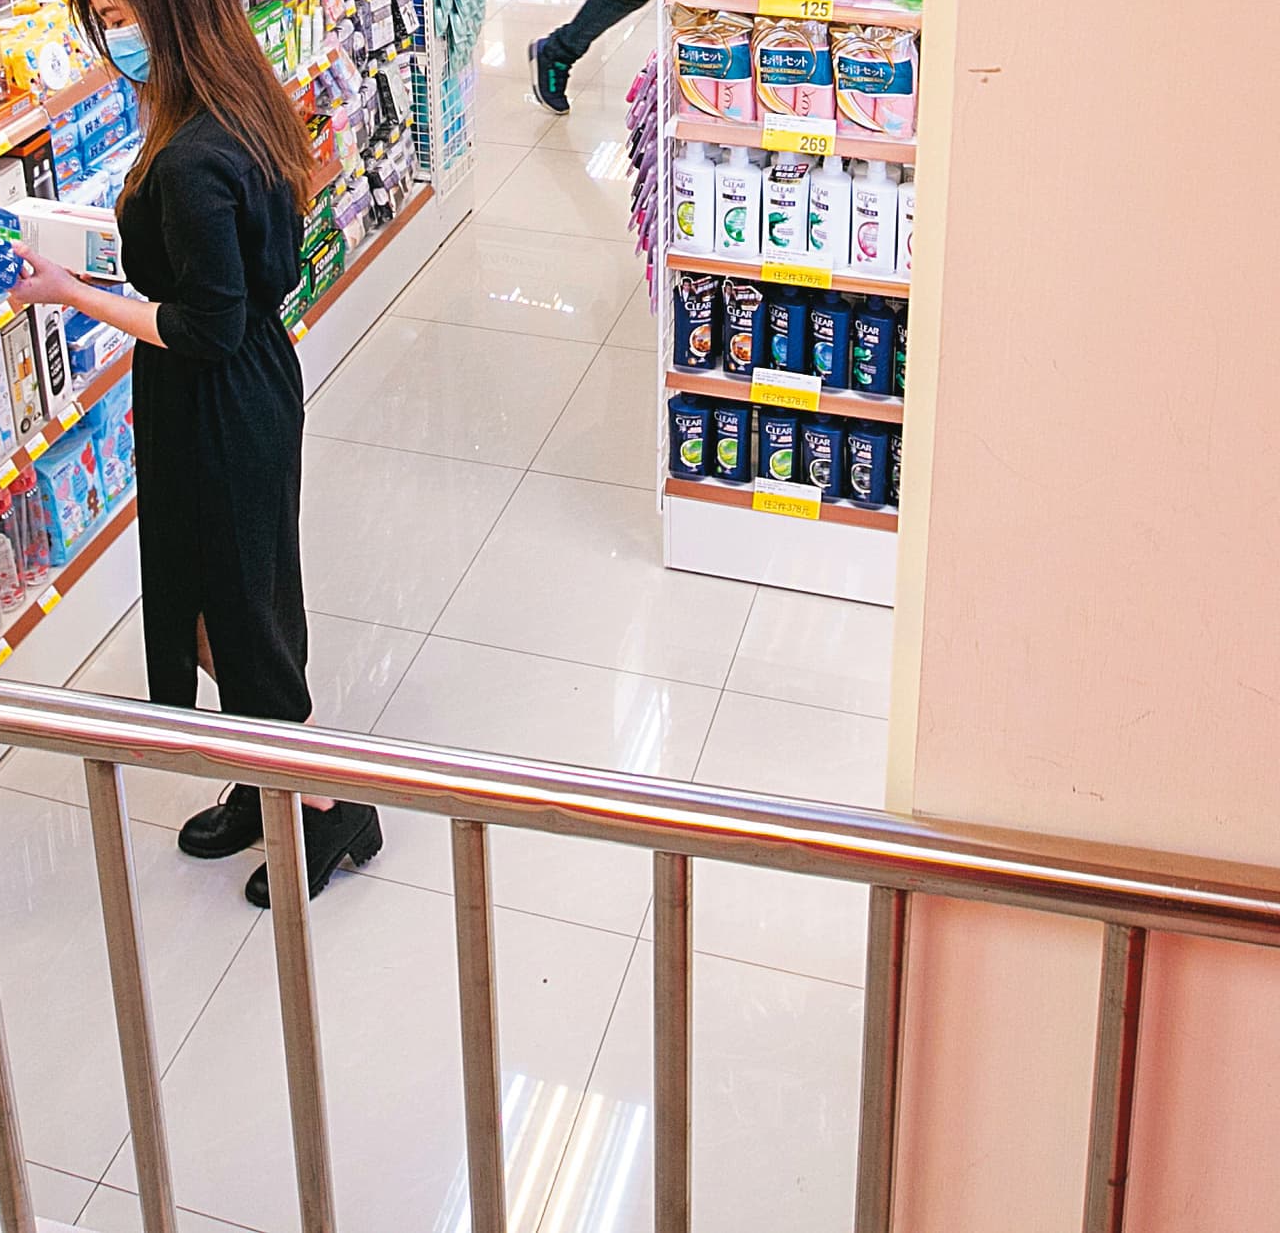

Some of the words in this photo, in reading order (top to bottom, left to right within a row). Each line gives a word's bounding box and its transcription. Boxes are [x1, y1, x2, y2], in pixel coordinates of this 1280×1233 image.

[801, 1, 829, 17] 125
[679, 49, 724, 62] お得セット
[761, 54, 809, 68] お得セット
[839, 63, 886, 77] お得セット
[799, 136, 828, 152] 269
[684, 302, 712, 311] CLEAR
[726, 305, 753, 319] CLEAR
[810, 311, 834, 328] CLEAR
[855, 319, 880, 336] CLEAR
[675, 417, 703, 427] CLEAR
[713, 411, 738, 425] CLEAR
[765, 424, 793, 435] CLEAR
[804, 432, 831, 447] CLEAR
[847, 436, 873, 451] CLEAR
